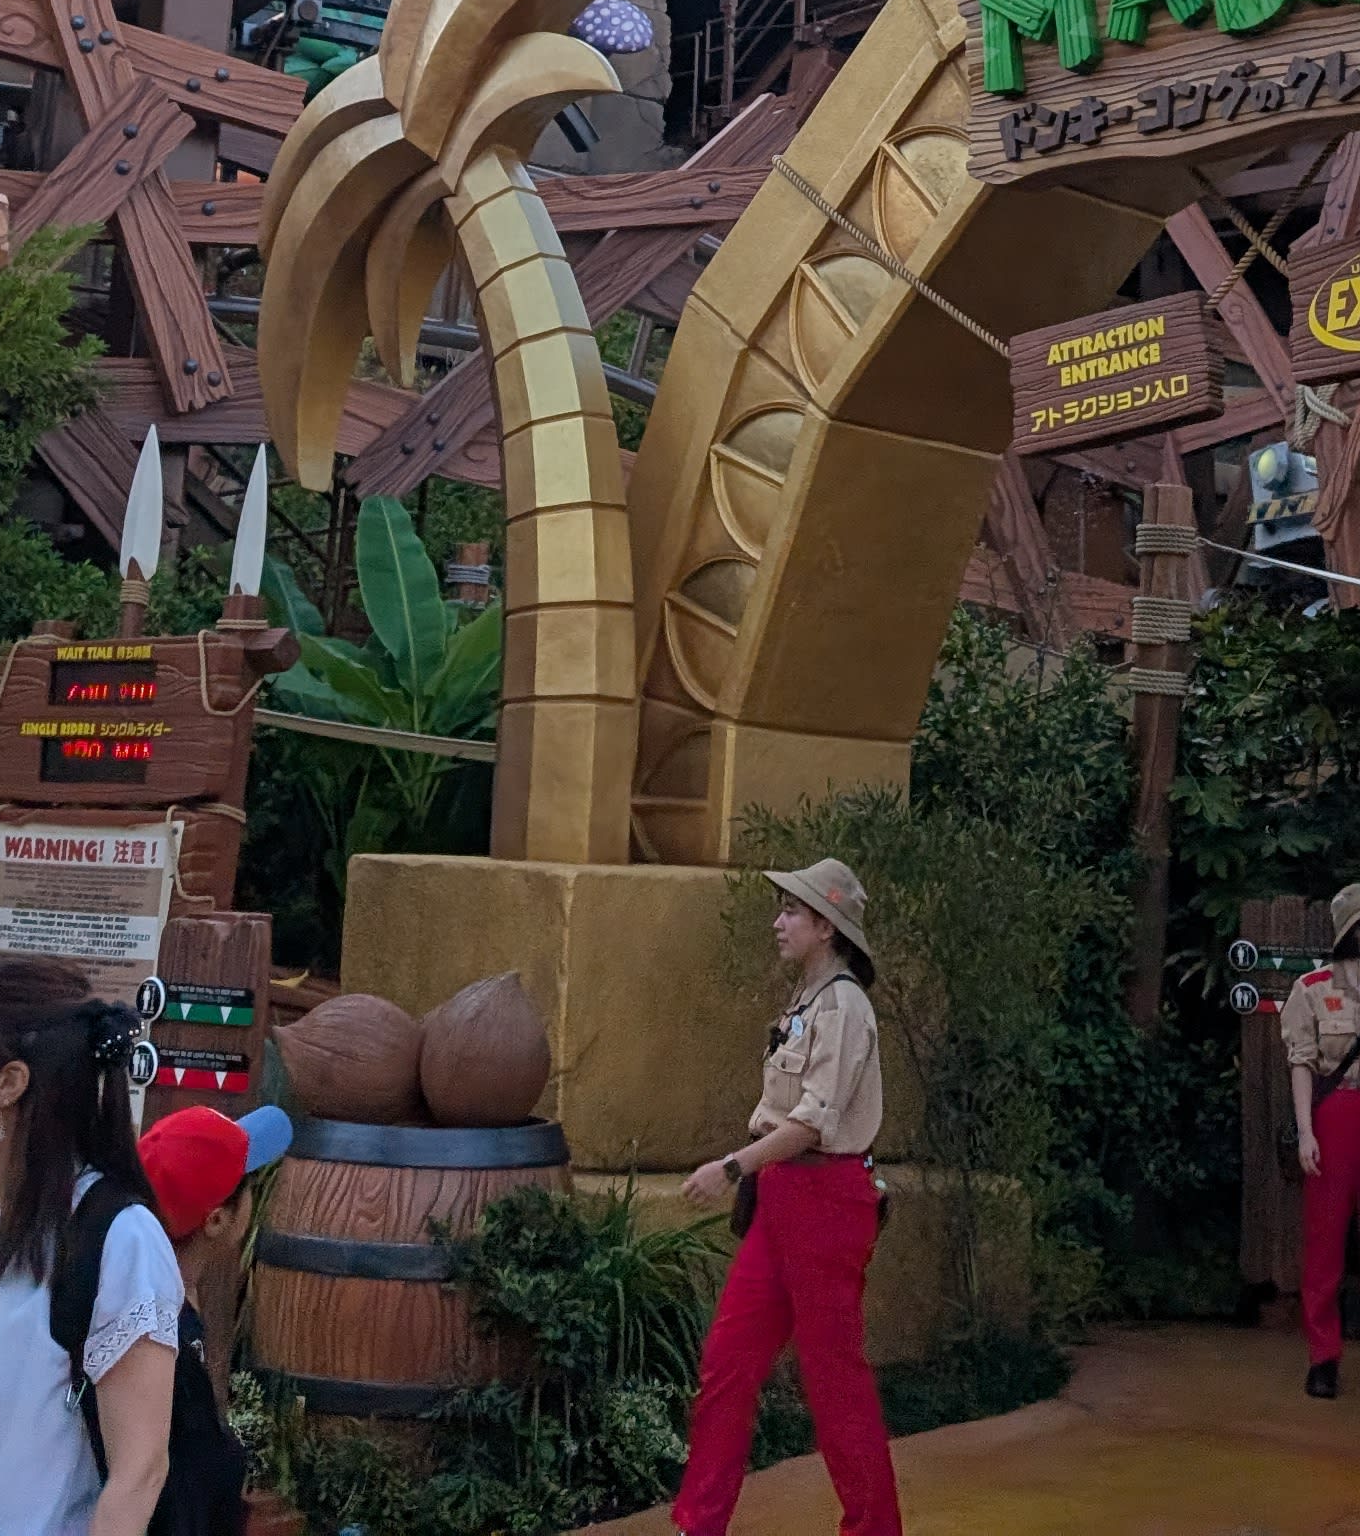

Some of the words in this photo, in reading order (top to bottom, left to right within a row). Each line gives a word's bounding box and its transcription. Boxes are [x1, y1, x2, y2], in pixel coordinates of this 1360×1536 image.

[1047, 316, 1166, 366] ATTRACTION
[1060, 342, 1162, 387] ENTRANCE
[1030, 374, 1189, 432] アトラクション入口
[57, 646, 85, 660] WAIT
[87, 646, 113, 660] TIME
[20, 722, 58, 736] SINGLE
[60, 722, 96, 736] RIDERS
[100, 722, 172, 736] シングルライダー
[5, 836, 105, 862] WARNING!
